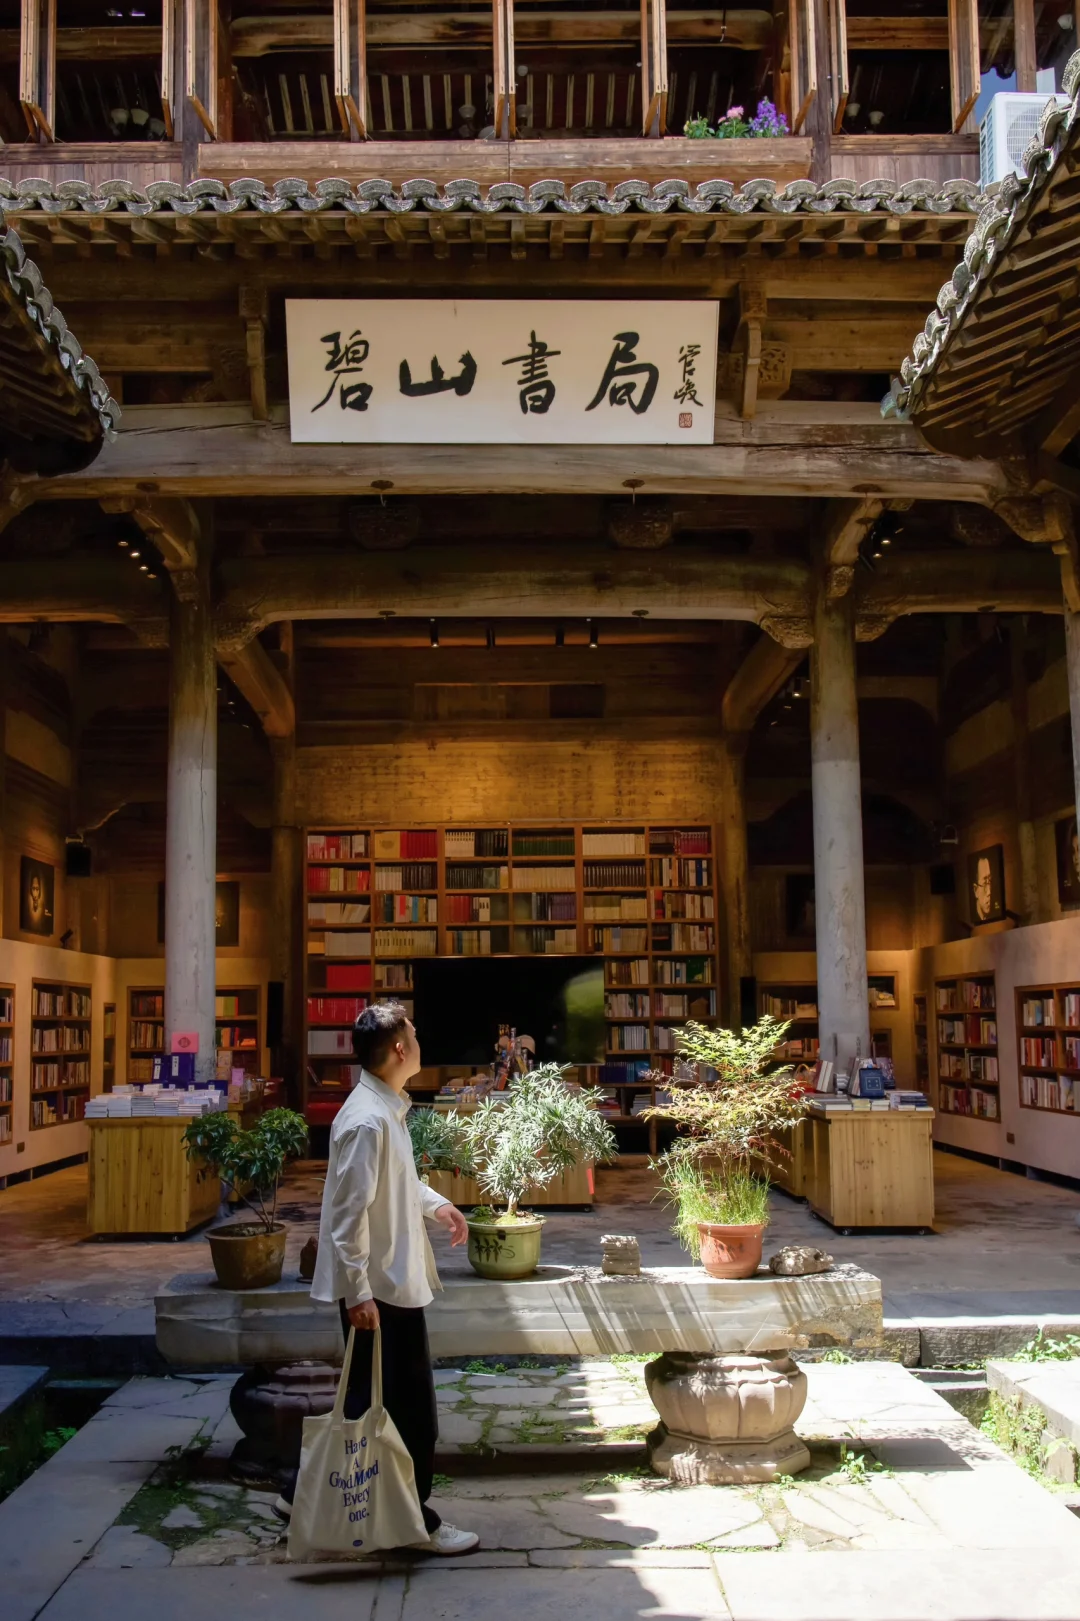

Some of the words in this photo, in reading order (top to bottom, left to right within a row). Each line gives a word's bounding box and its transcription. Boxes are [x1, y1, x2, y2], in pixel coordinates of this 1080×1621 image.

[311, 330, 660, 414] 碧山書局
[352, 1456, 360, 1470] A
[329, 1471, 353, 1490] Good
[354, 1460, 379, 1486] Mood
[343, 1486, 370, 1507] Every
[349, 1507, 370, 1523] one.
